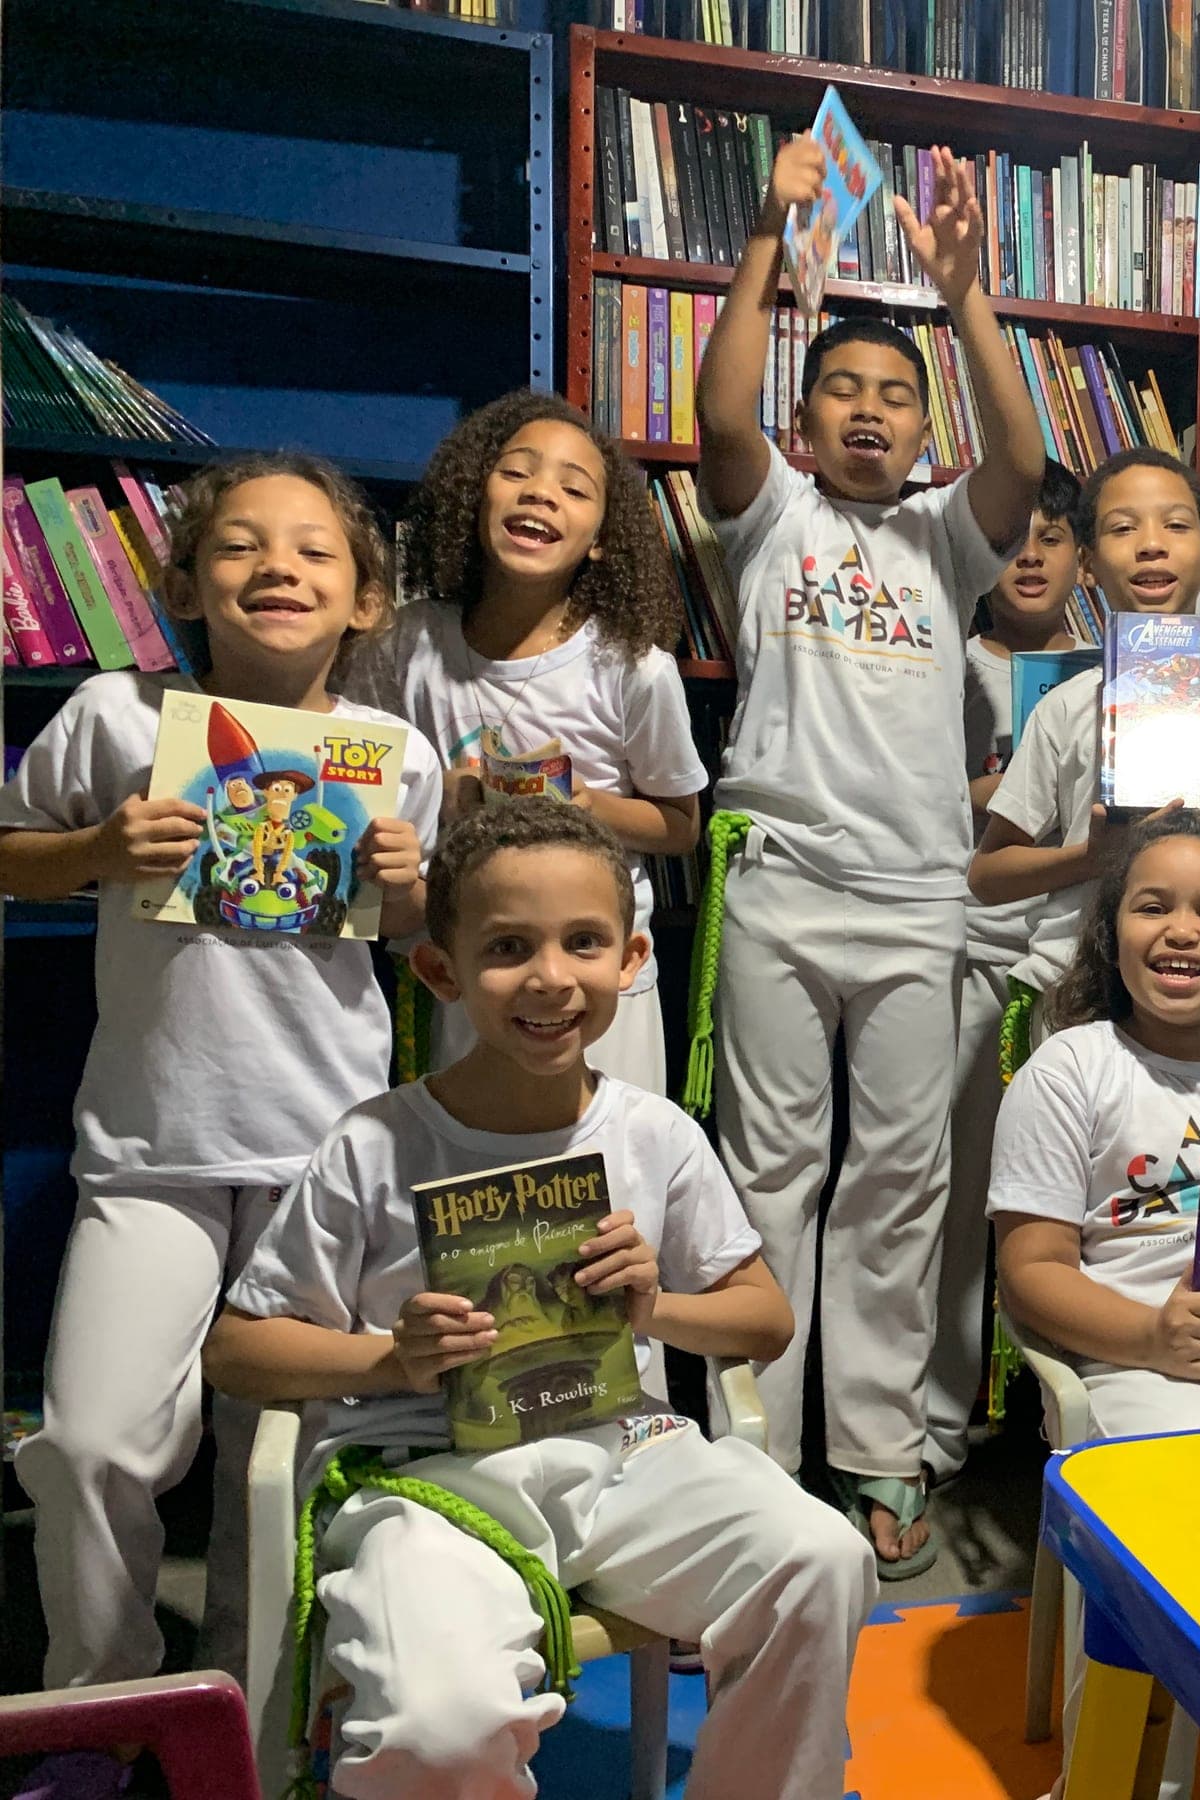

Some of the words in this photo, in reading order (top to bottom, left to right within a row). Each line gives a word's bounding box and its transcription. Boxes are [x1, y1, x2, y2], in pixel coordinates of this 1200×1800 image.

[1101, 47, 1109, 82] CHAMAS
[604, 136, 617, 206] FALLEN
[9, 581, 41, 633] Barbie
[802, 555, 900, 610] CASA
[899, 587, 923, 603] DE
[784, 587, 933, 650] BAMBAS
[324, 736, 393, 769] TOY
[327, 766, 378, 782] STORY
[428, 1184, 512, 1237] Harry
[512, 1170, 601, 1223] Potter
[470, 1241, 511, 1267] enigma
[488, 1404, 503, 1426] J.
[509, 1396, 534, 1416] K.
[539, 1380, 608, 1406] Rowling
